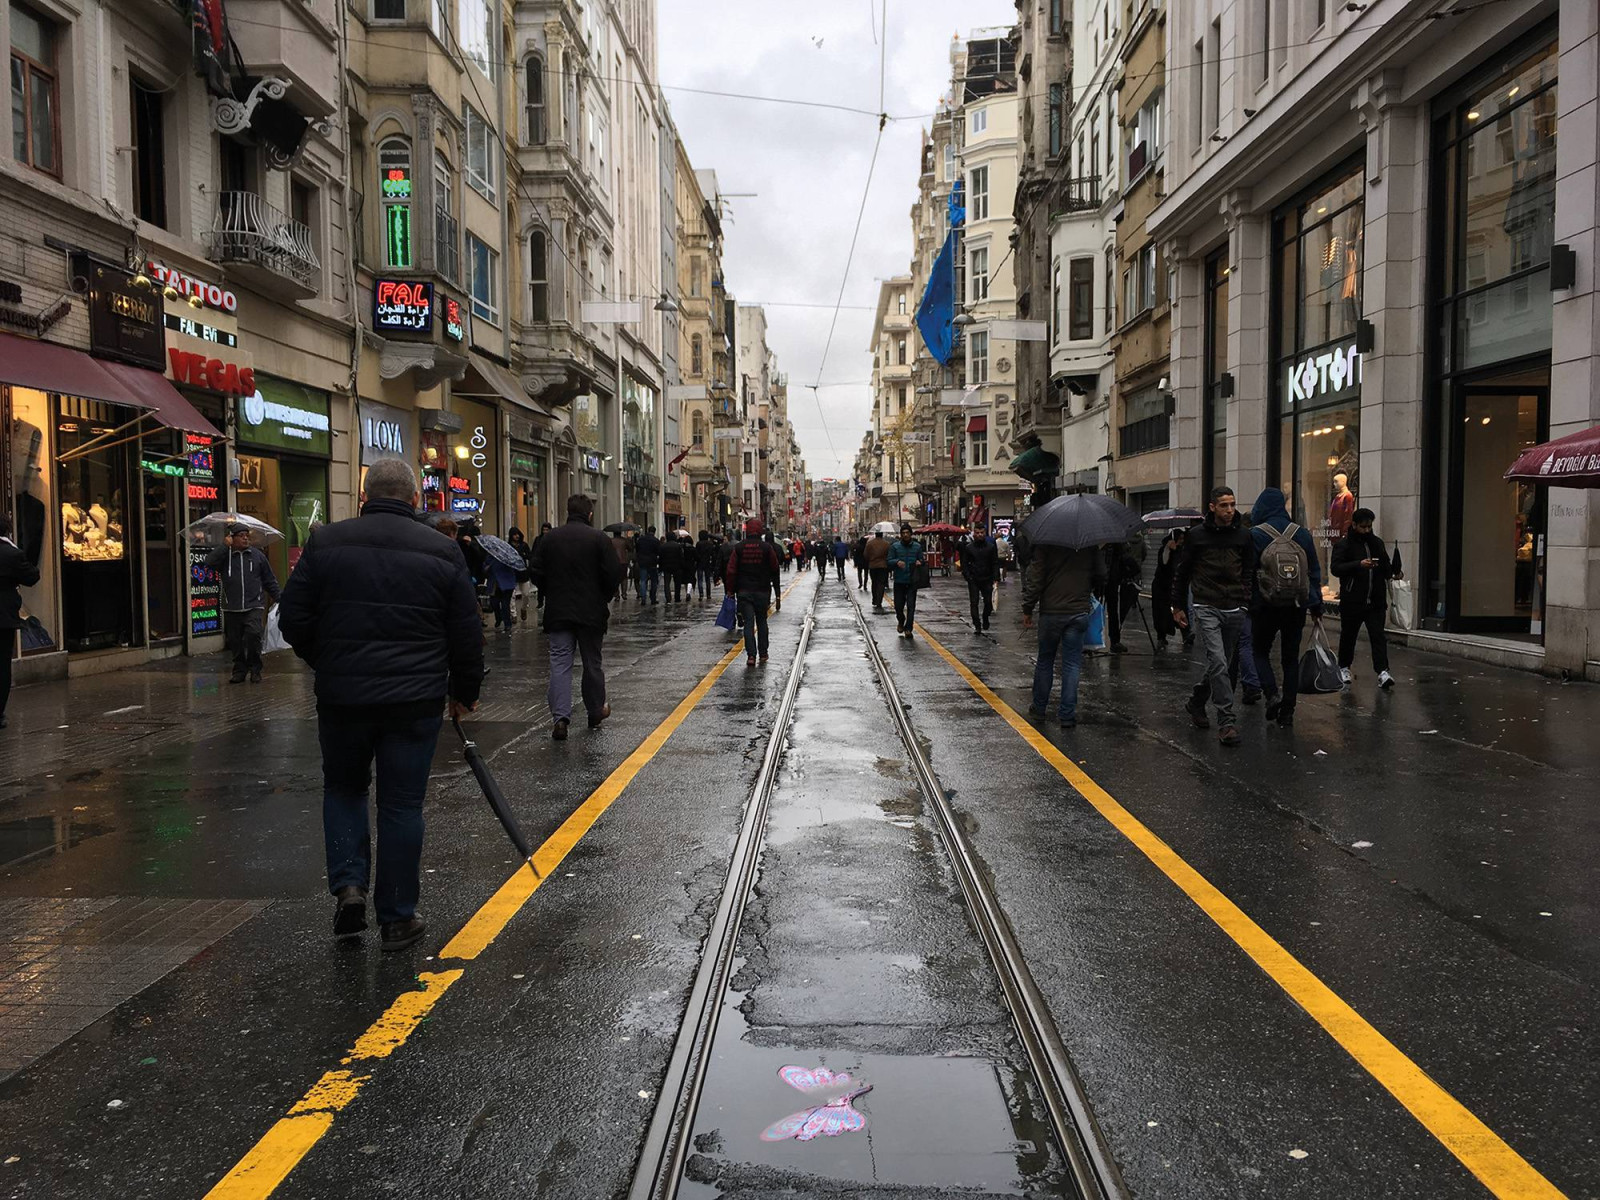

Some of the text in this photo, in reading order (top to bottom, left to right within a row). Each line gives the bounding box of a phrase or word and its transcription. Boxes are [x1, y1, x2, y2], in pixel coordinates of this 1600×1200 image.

[149, 263, 237, 311] TATTOO
[379, 281, 429, 306] FAL
[180, 317, 198, 337] FAL
[168, 348, 255, 397] VEGAS
[367, 417, 404, 454] LOYA
[995, 393, 1010, 460] PEVA
[1551, 453, 1588, 473] BEYOĞLU
